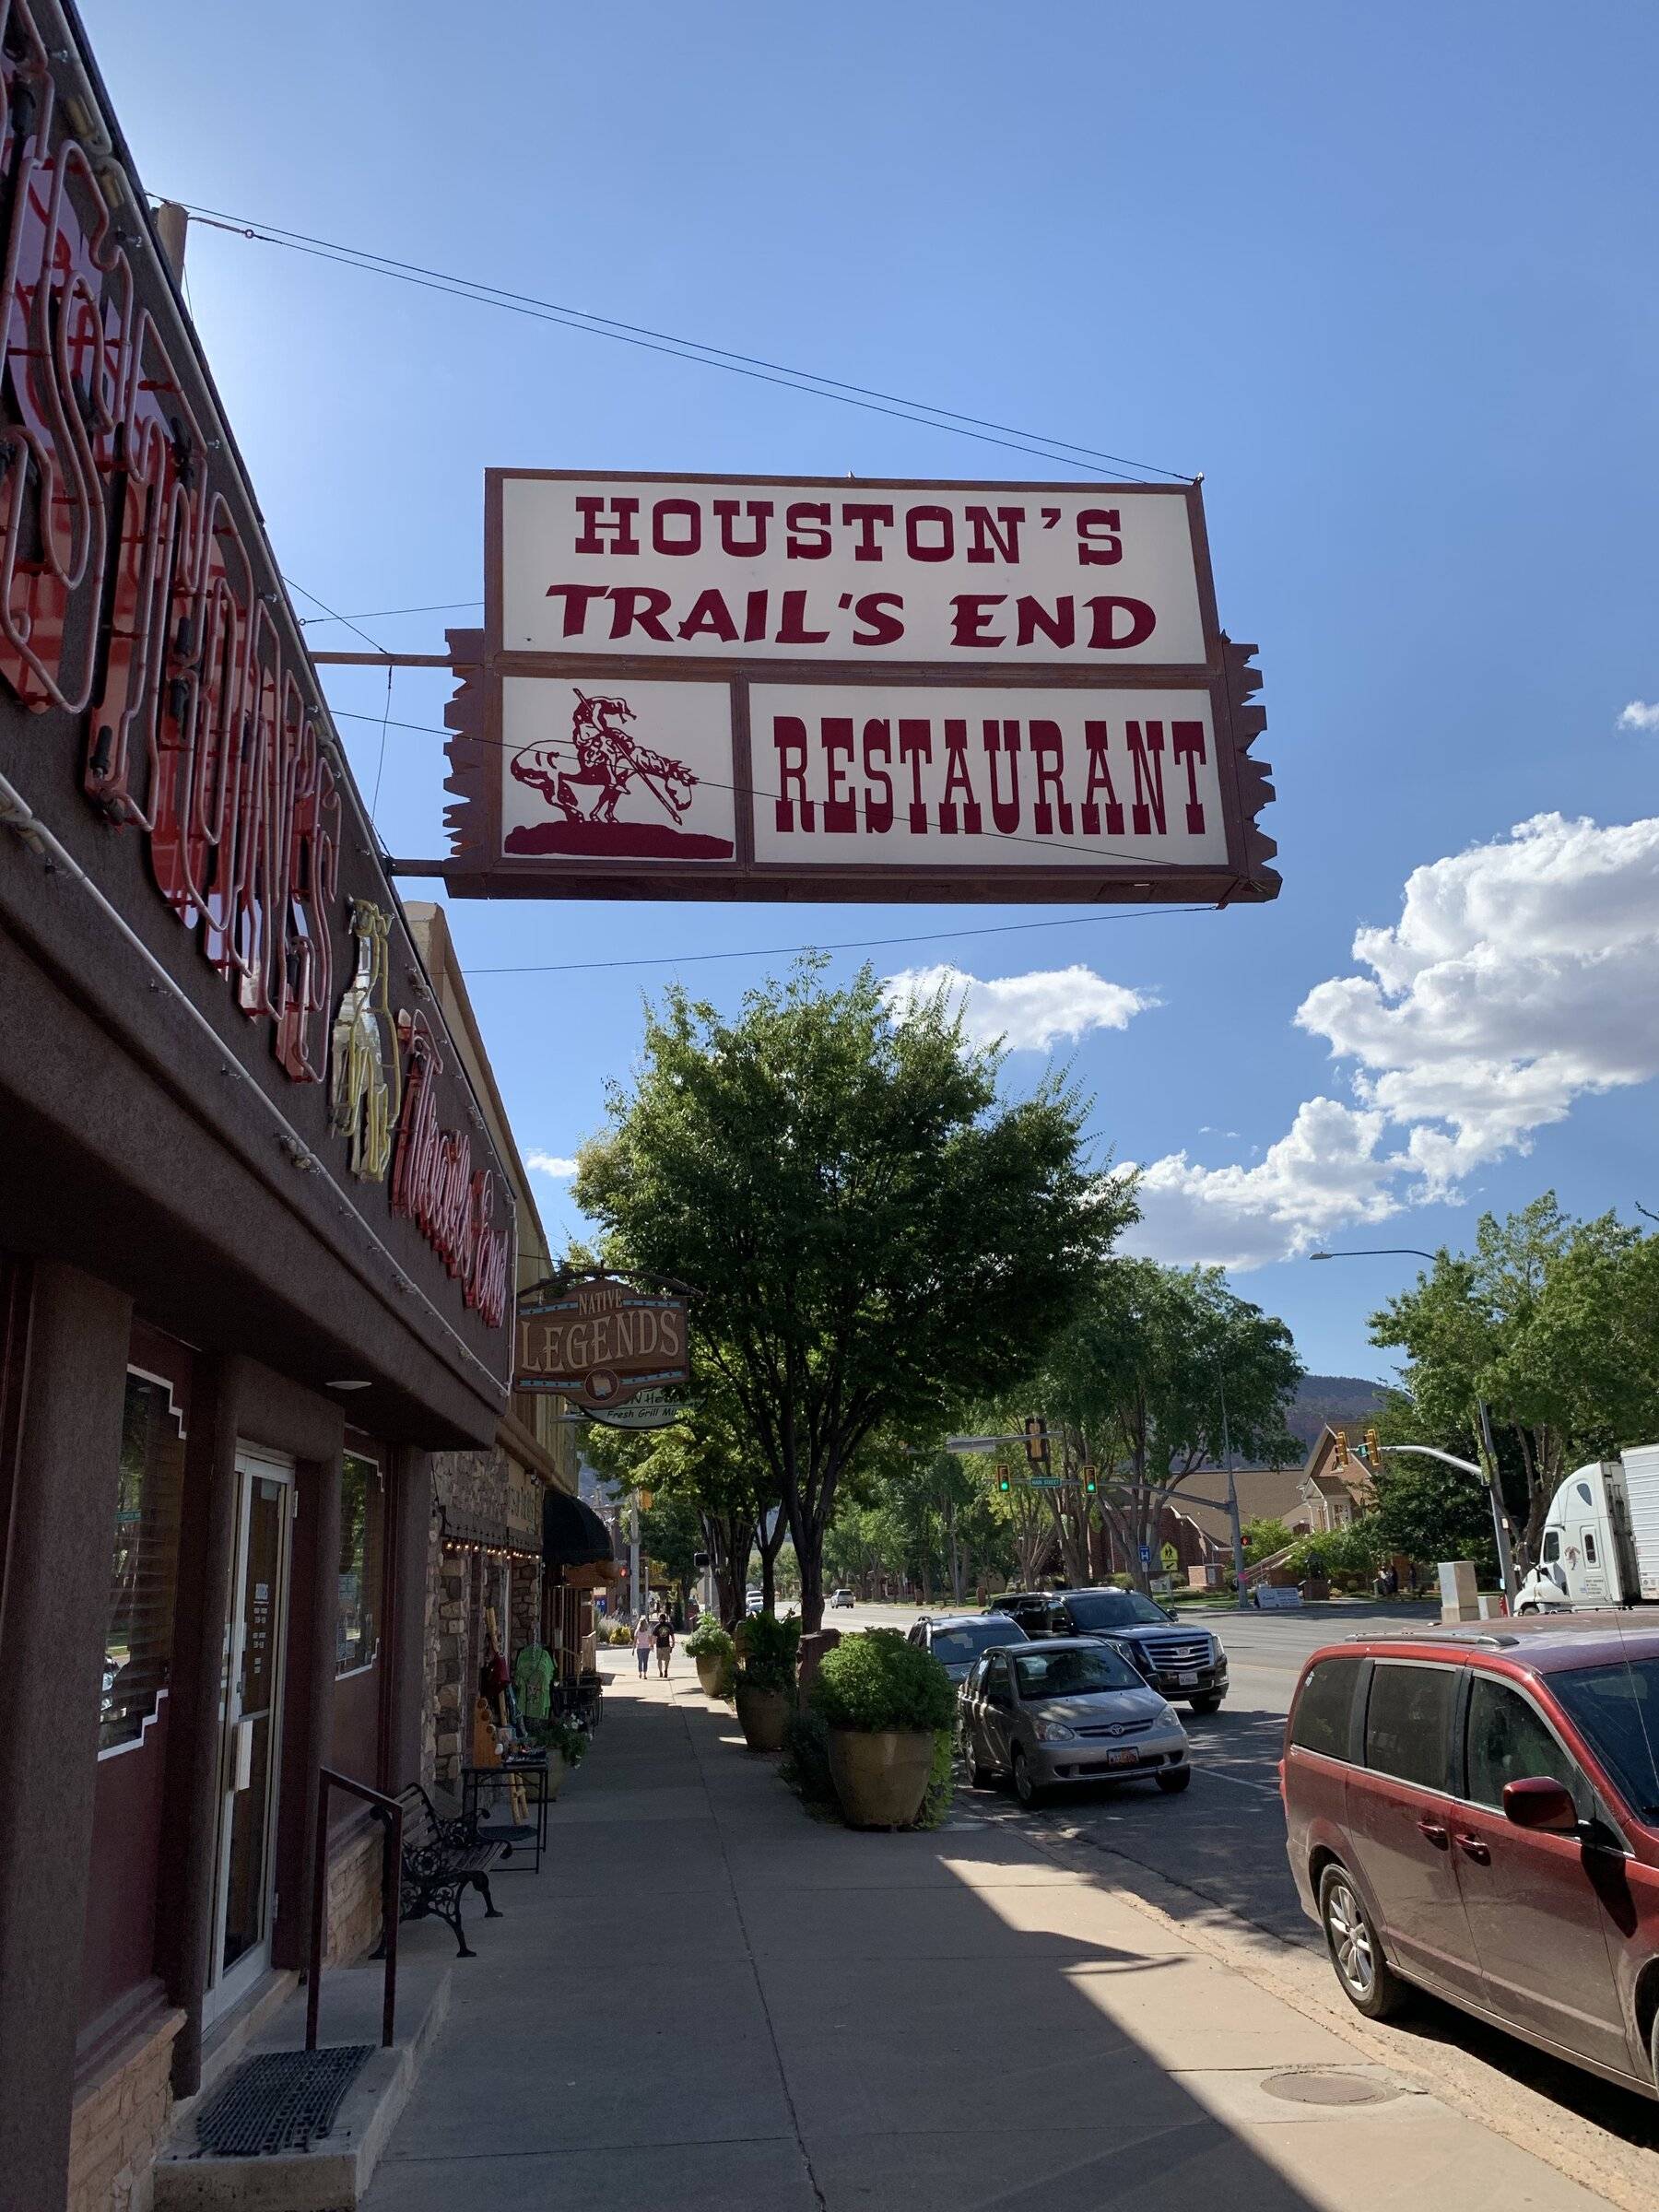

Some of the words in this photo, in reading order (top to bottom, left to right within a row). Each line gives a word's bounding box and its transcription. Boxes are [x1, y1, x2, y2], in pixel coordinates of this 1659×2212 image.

[576, 498, 1121, 565] HOUSTON'S
[546, 585, 904, 645] TRAIL'S
[950, 595, 1155, 648] END
[774, 717, 1205, 834] RESTAURANT
[578, 1288, 624, 1316] NATIVE
[521, 1309, 679, 1372] LEGENDS
[606, 1410, 635, 1419] Fresh
[638, 1407, 658, 1418] Grill
